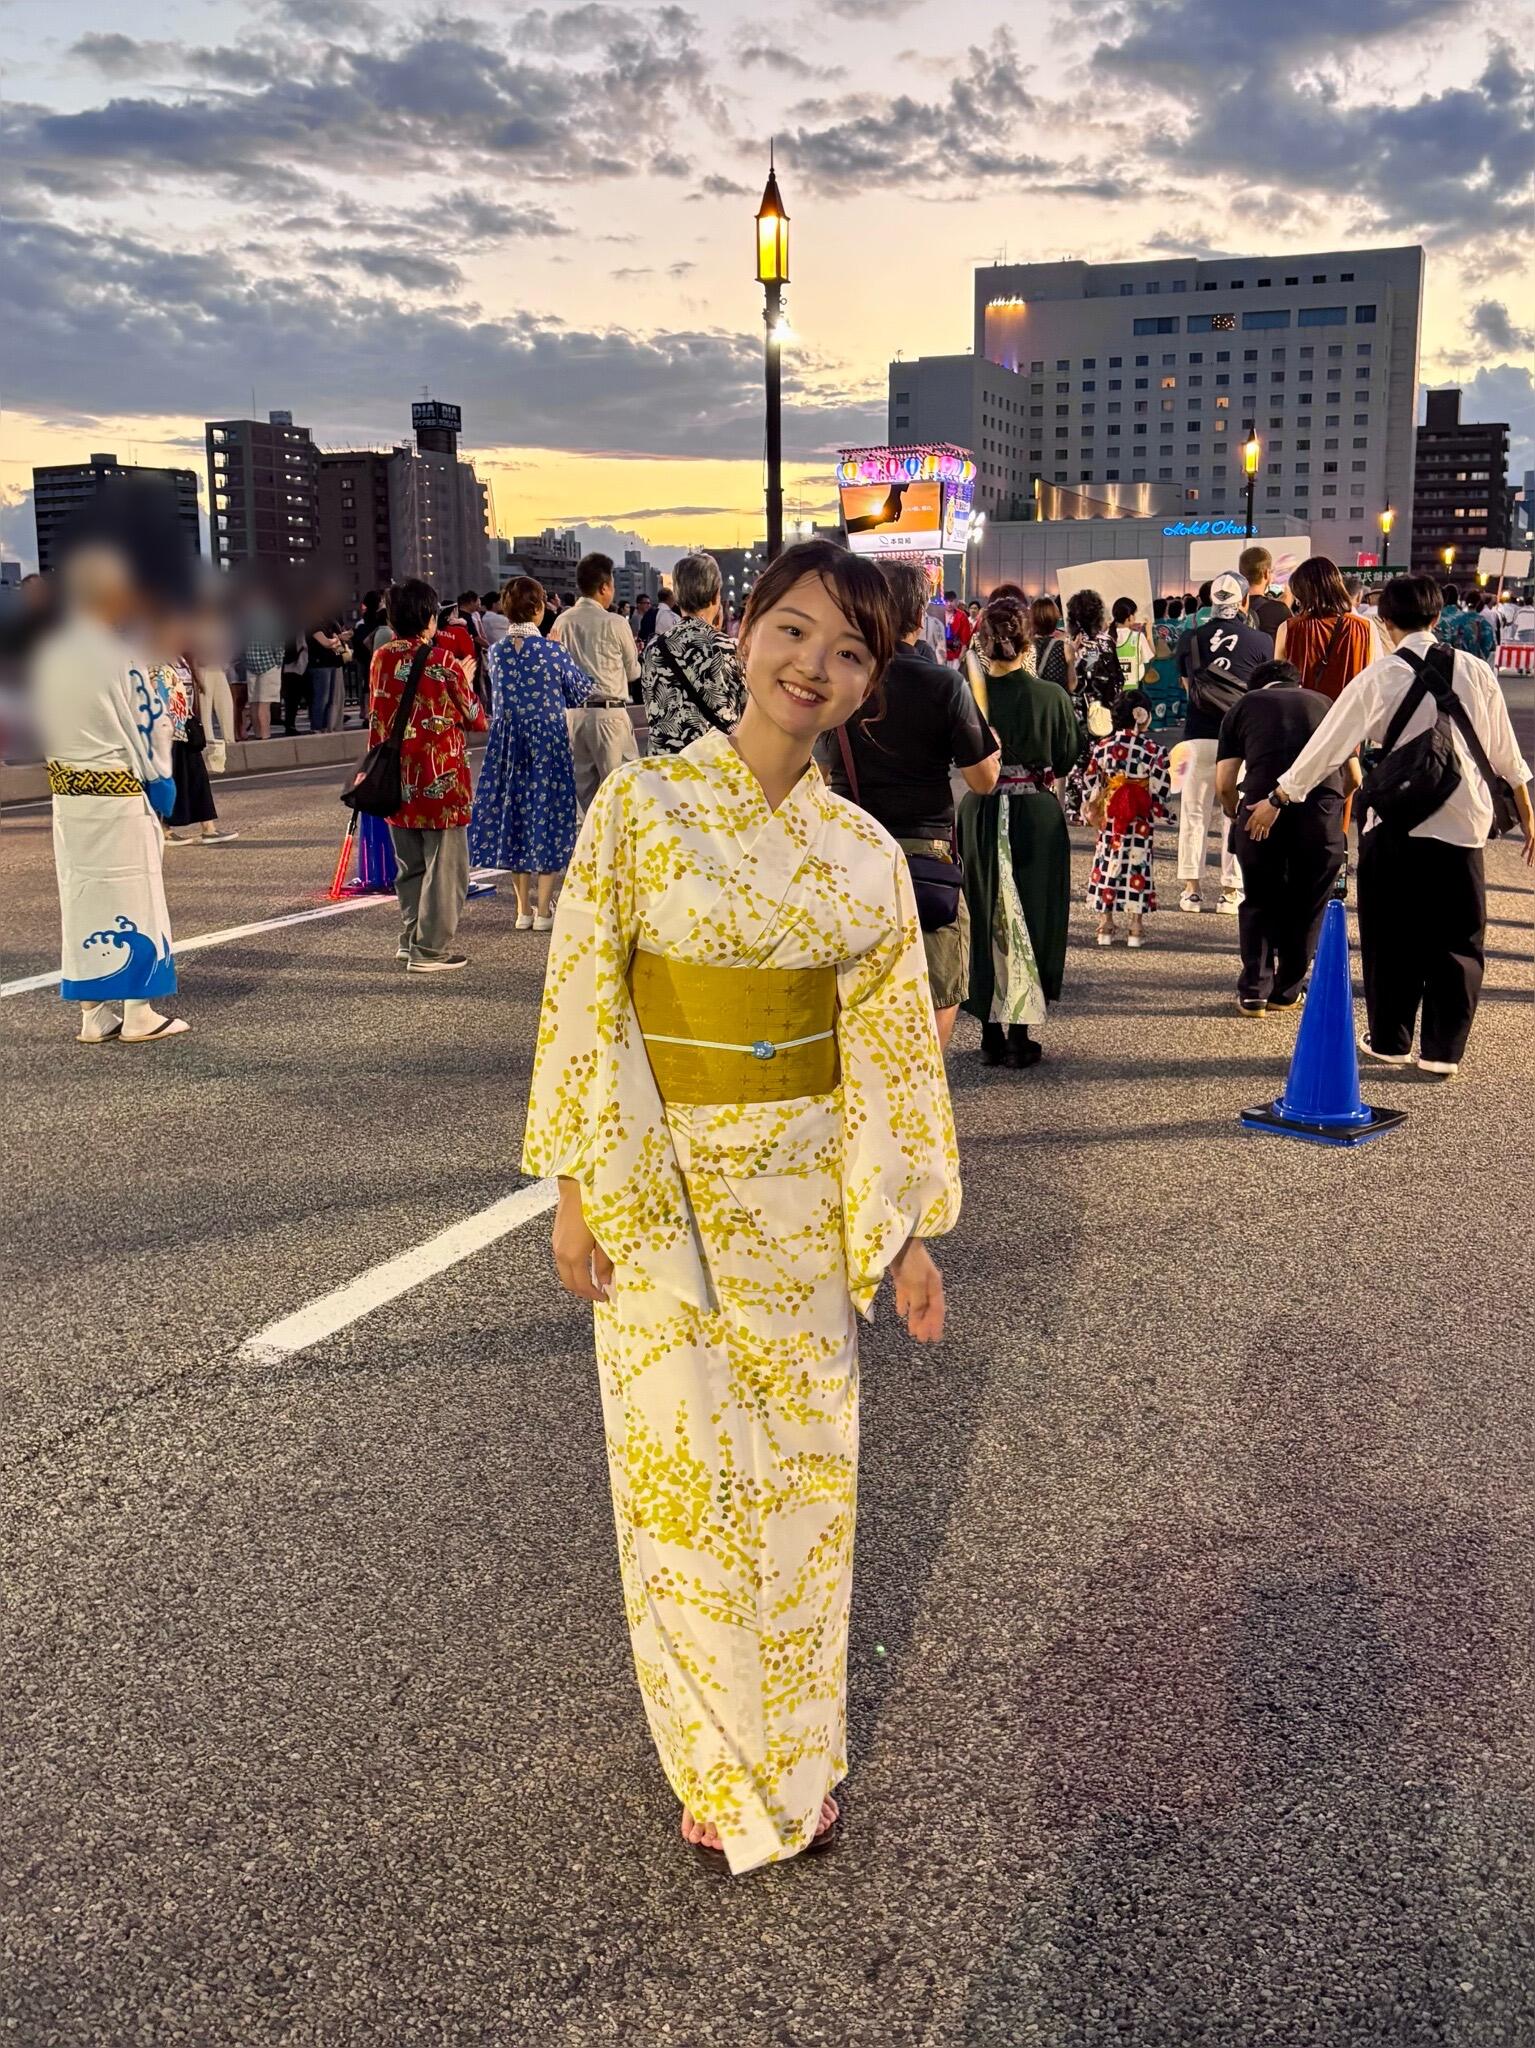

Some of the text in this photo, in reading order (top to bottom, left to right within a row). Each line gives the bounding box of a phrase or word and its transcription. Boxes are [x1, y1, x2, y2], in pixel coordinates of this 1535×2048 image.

[413, 405, 436, 418] DIA
[441, 405, 458, 420] DIA
[1163, 521, 1210, 536] Hotel
